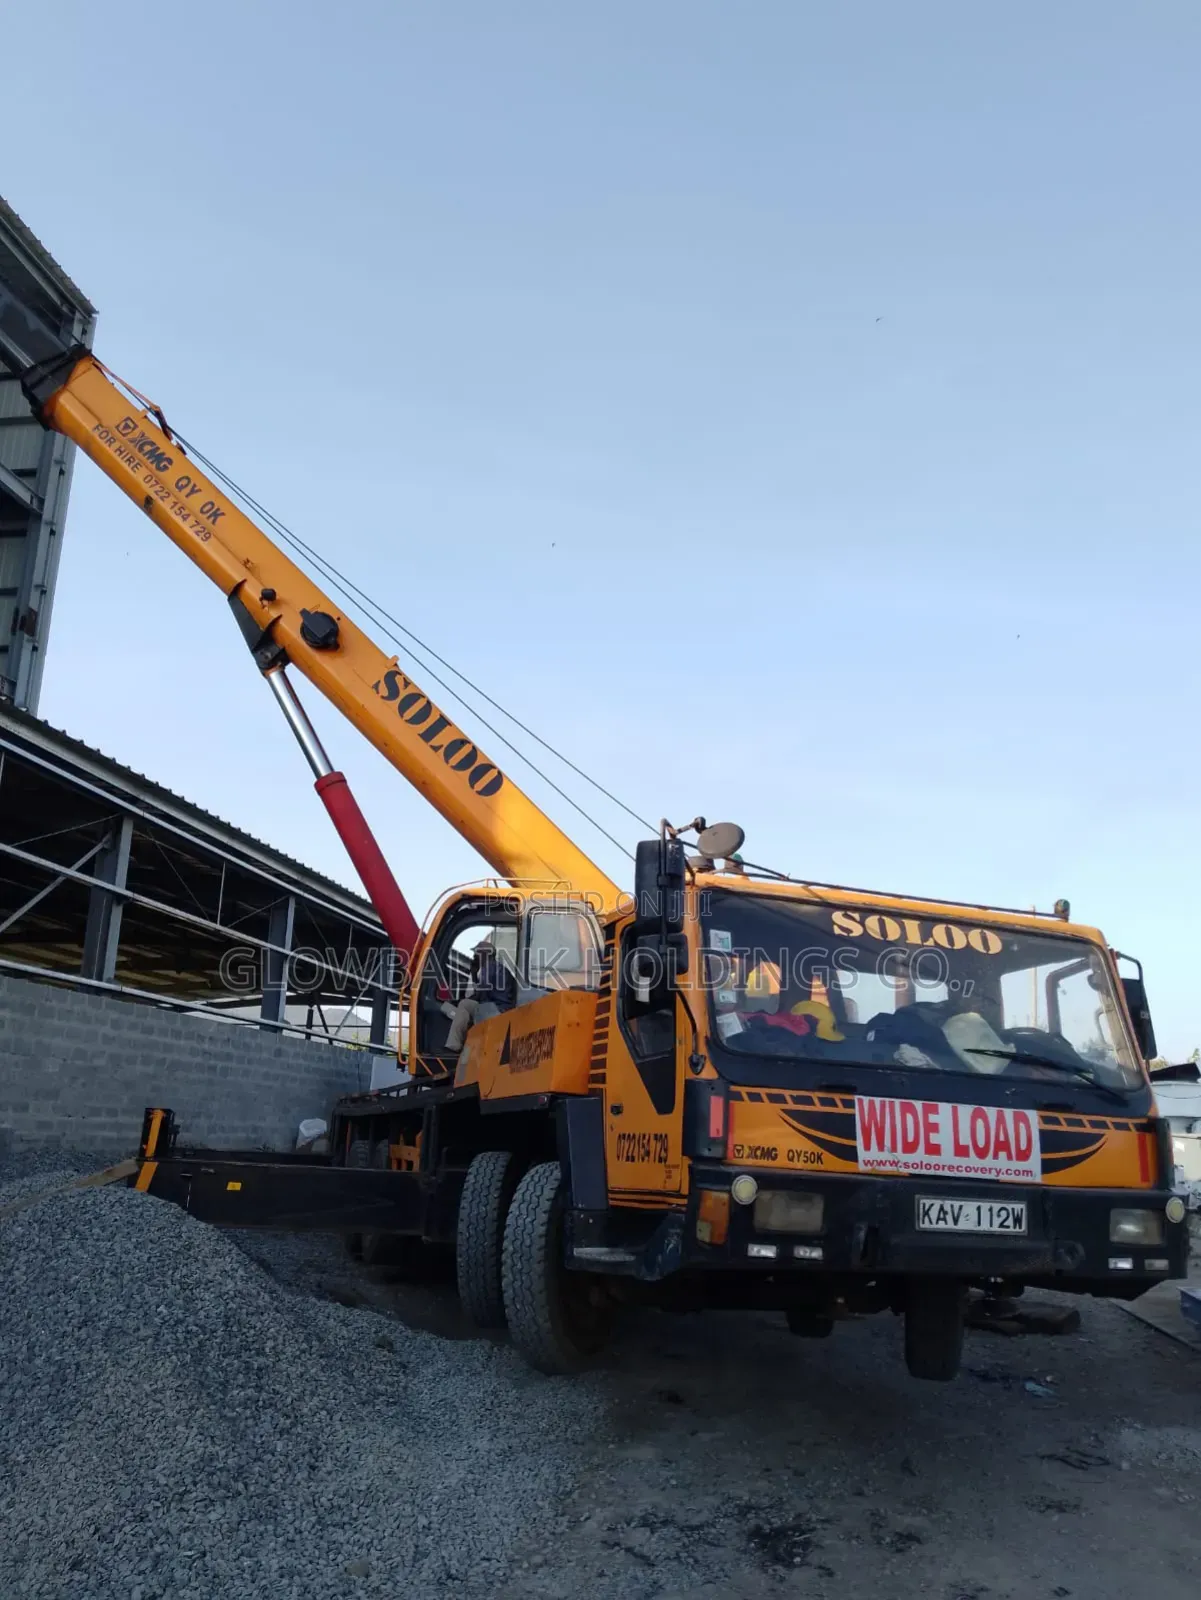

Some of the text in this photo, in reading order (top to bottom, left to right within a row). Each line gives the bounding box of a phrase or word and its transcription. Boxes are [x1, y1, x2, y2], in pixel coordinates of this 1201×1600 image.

[93, 423, 213, 543] FOR HIRE 0722 154 729
[128, 431, 174, 473] XCMG
[174, 475, 202, 499] QY
[371, 669, 504, 797] SOLOO
[831, 910, 1003, 955] SOLOO
[747, 1144, 824, 1165] XCMG QY50K
[857, 1097, 1033, 1163] WIDE LOAD
[862, 1157, 1034, 1178] www.soloorecovery.com
[921, 1202, 1024, 1231] KAV 112W
